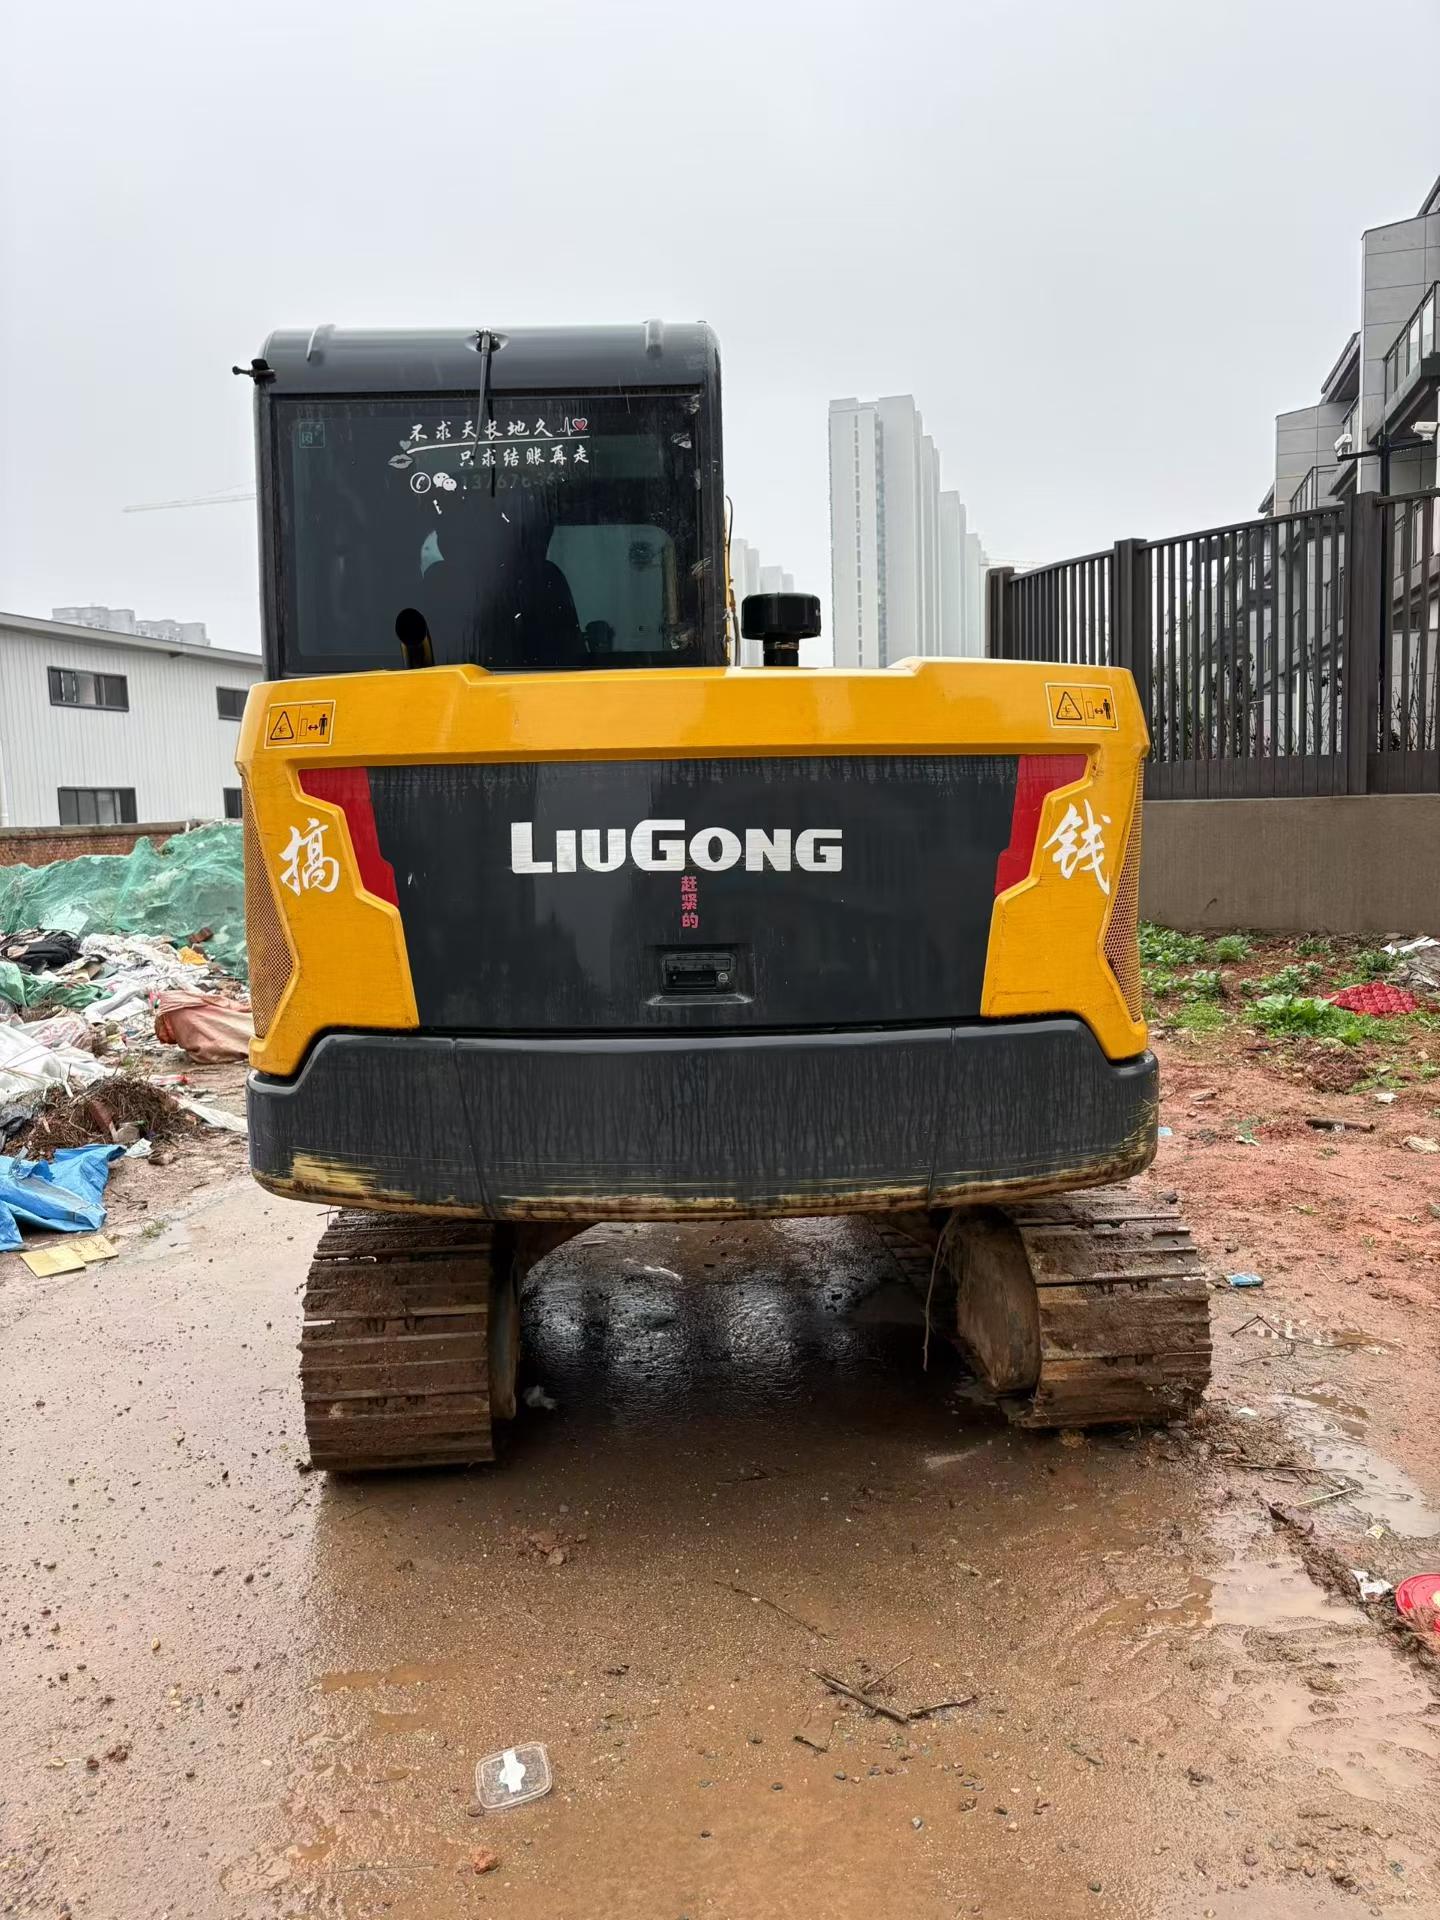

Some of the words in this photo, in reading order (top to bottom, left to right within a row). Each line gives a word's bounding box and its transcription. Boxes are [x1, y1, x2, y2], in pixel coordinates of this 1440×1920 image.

[459, 444, 590, 468] 只求结账再走
[278, 817, 340, 897] 搞
[1042, 798, 1112, 896] 钱
[680, 875, 699, 929] 赶紧的
